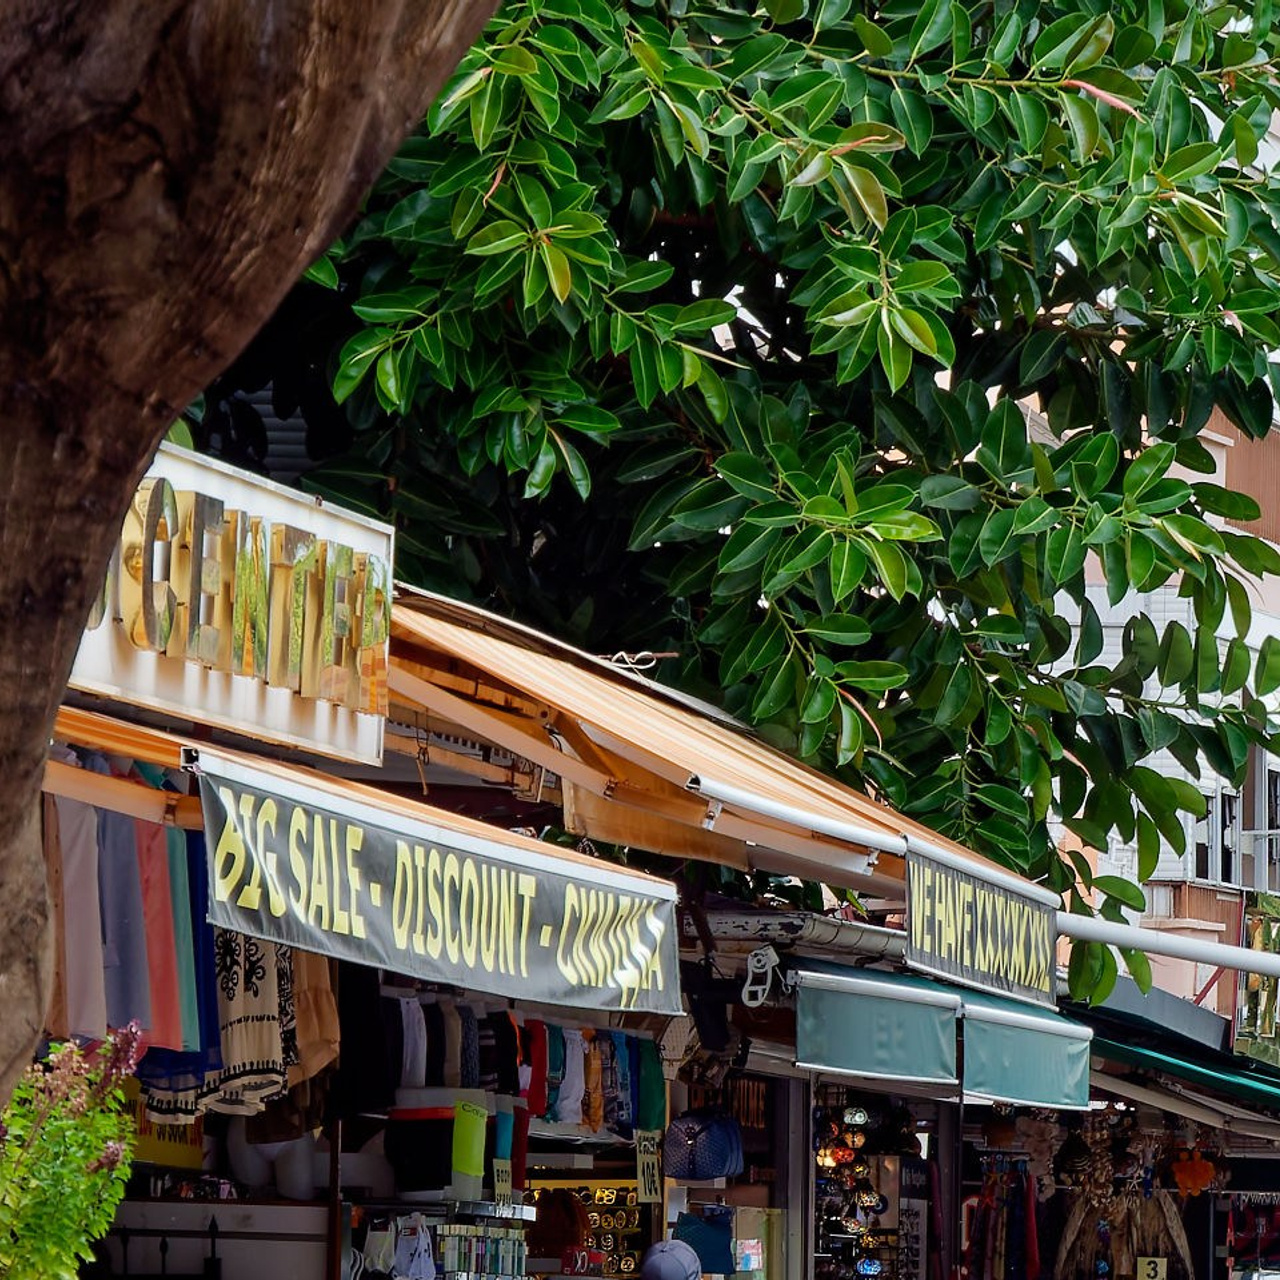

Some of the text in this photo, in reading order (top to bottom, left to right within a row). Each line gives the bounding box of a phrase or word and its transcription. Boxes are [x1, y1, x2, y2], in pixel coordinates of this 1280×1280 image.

[288, 806, 366, 939] SALE
[393, 840, 536, 978] DISCOUNT
[908, 861, 931, 953] WE
[935, 872, 973, 967] HAVE
[1146, 1260, 1159, 1280] 3
